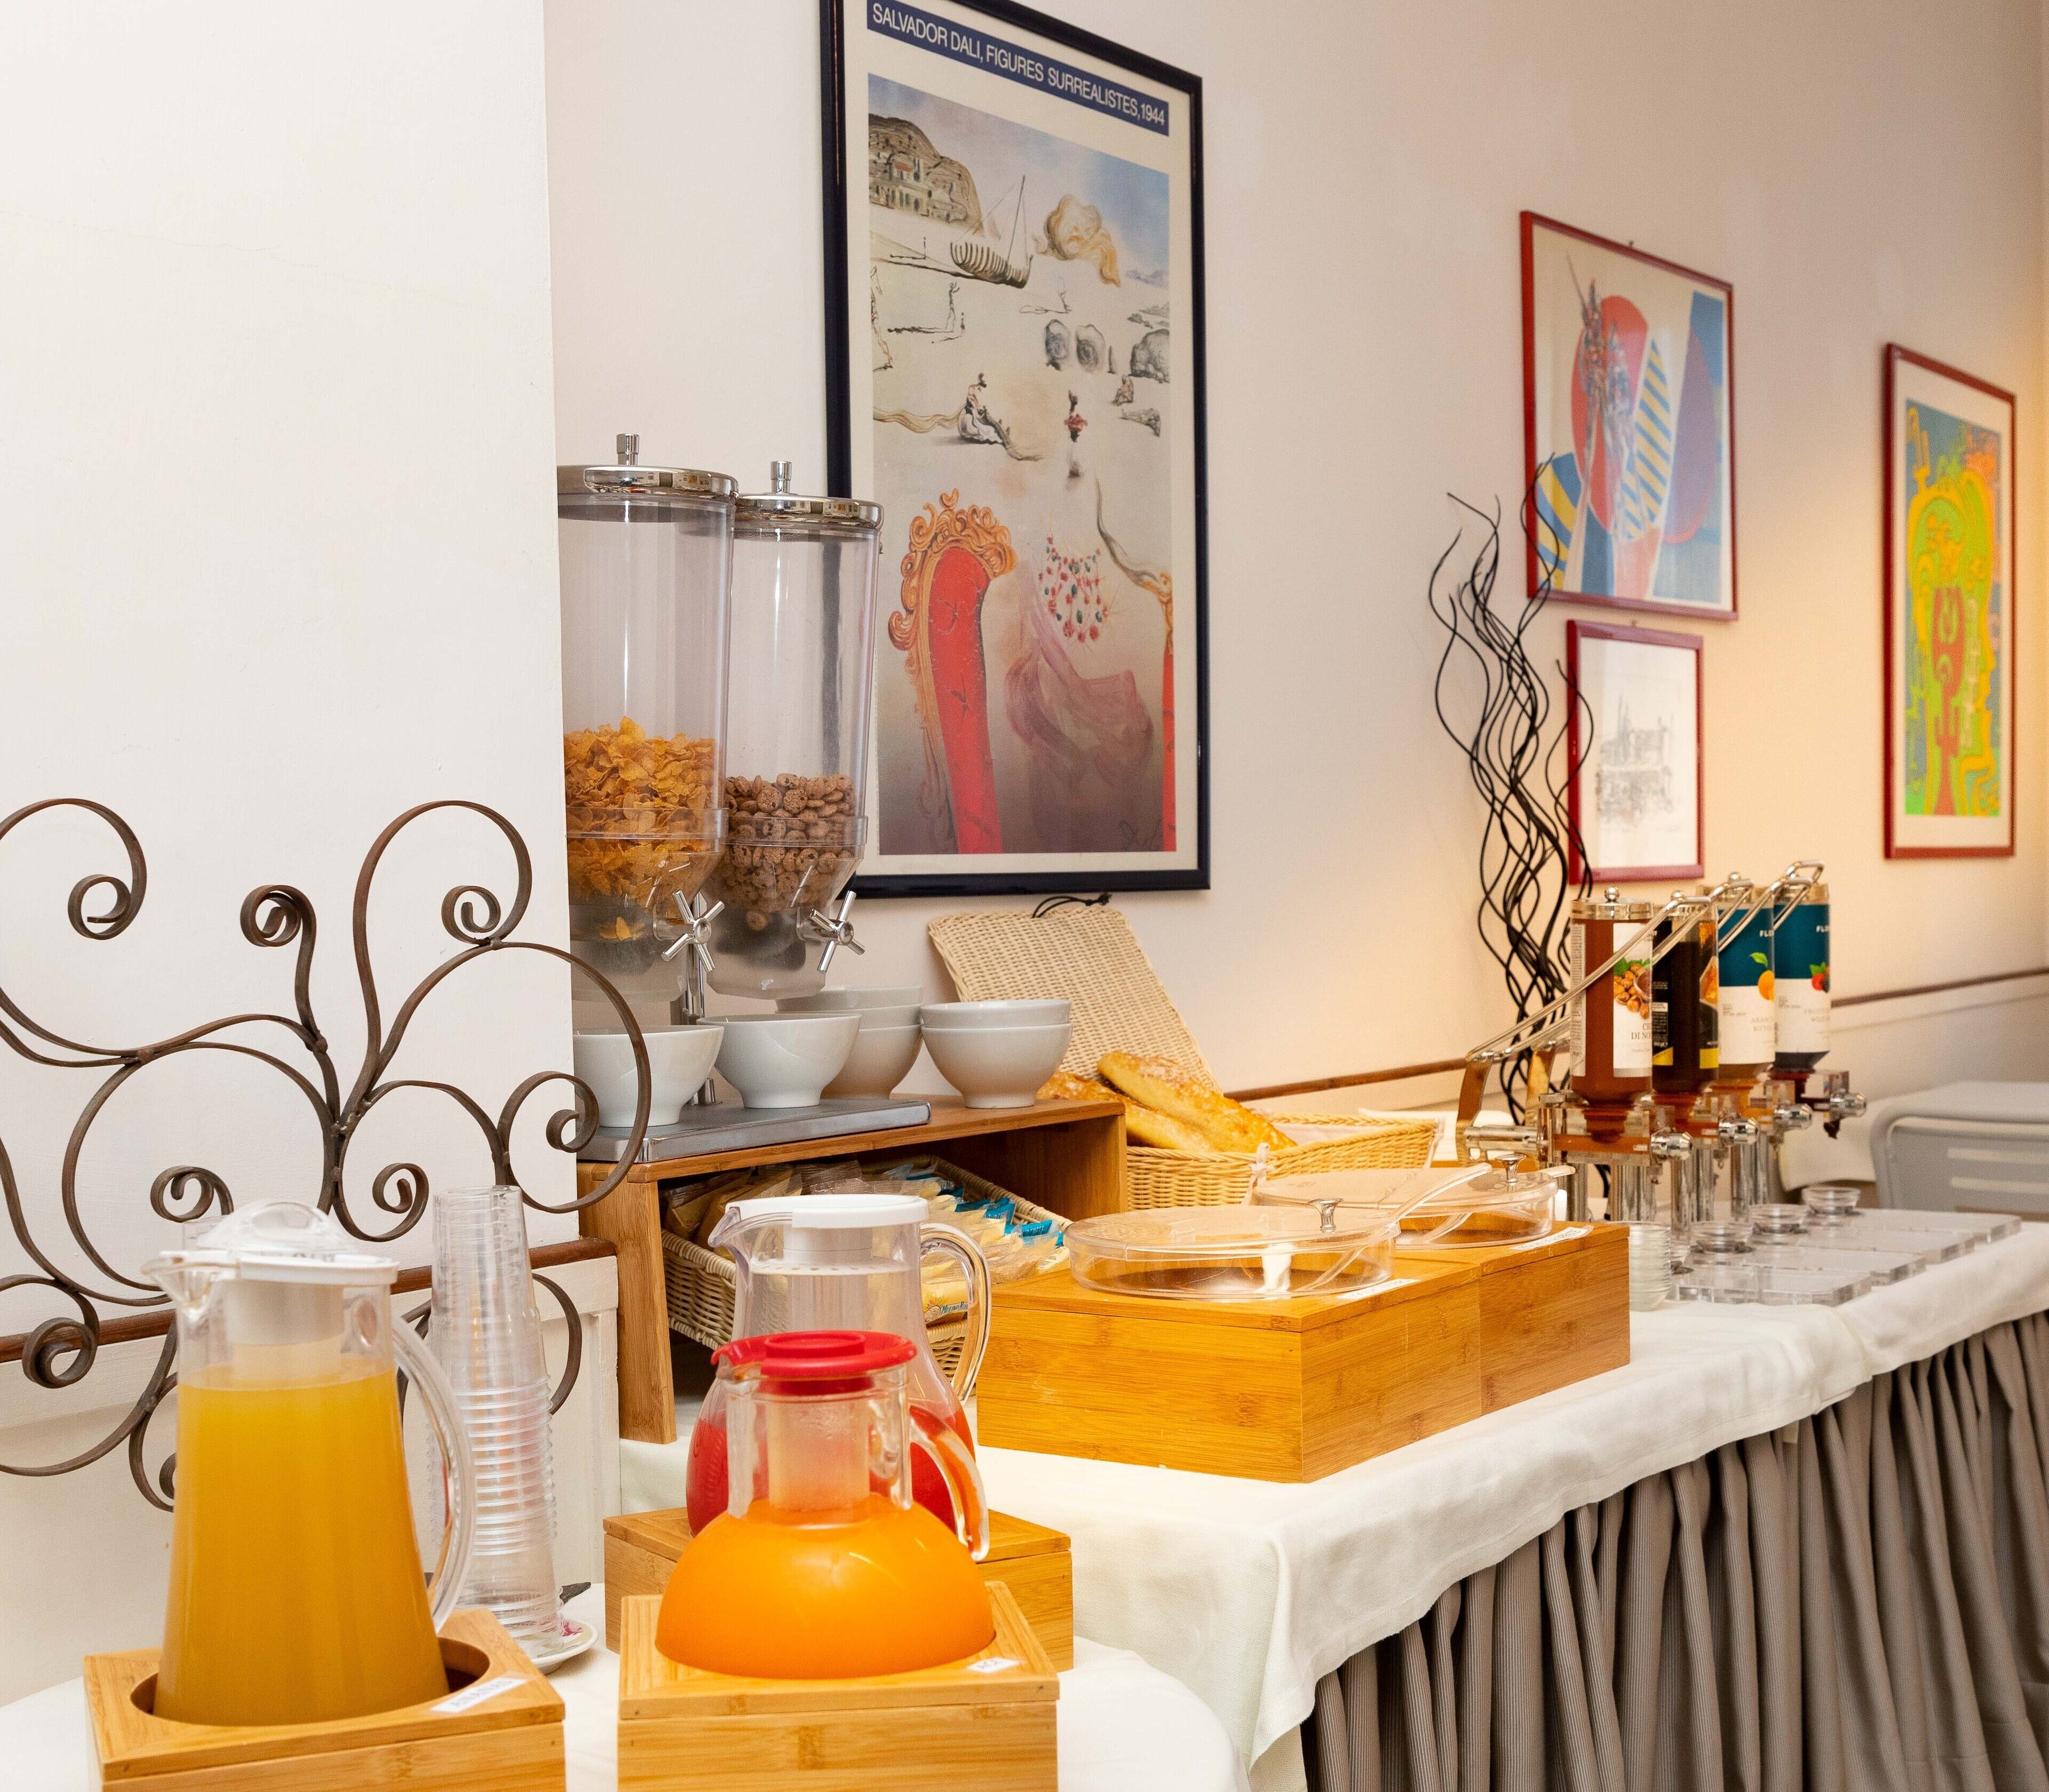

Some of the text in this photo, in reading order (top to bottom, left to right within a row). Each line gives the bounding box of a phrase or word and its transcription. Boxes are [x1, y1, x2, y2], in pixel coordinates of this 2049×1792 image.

[873, 3, 948, 47] SALVADOR
[951, 31, 983, 64] DALI,
[986, 44, 1044, 82] FIGURES
